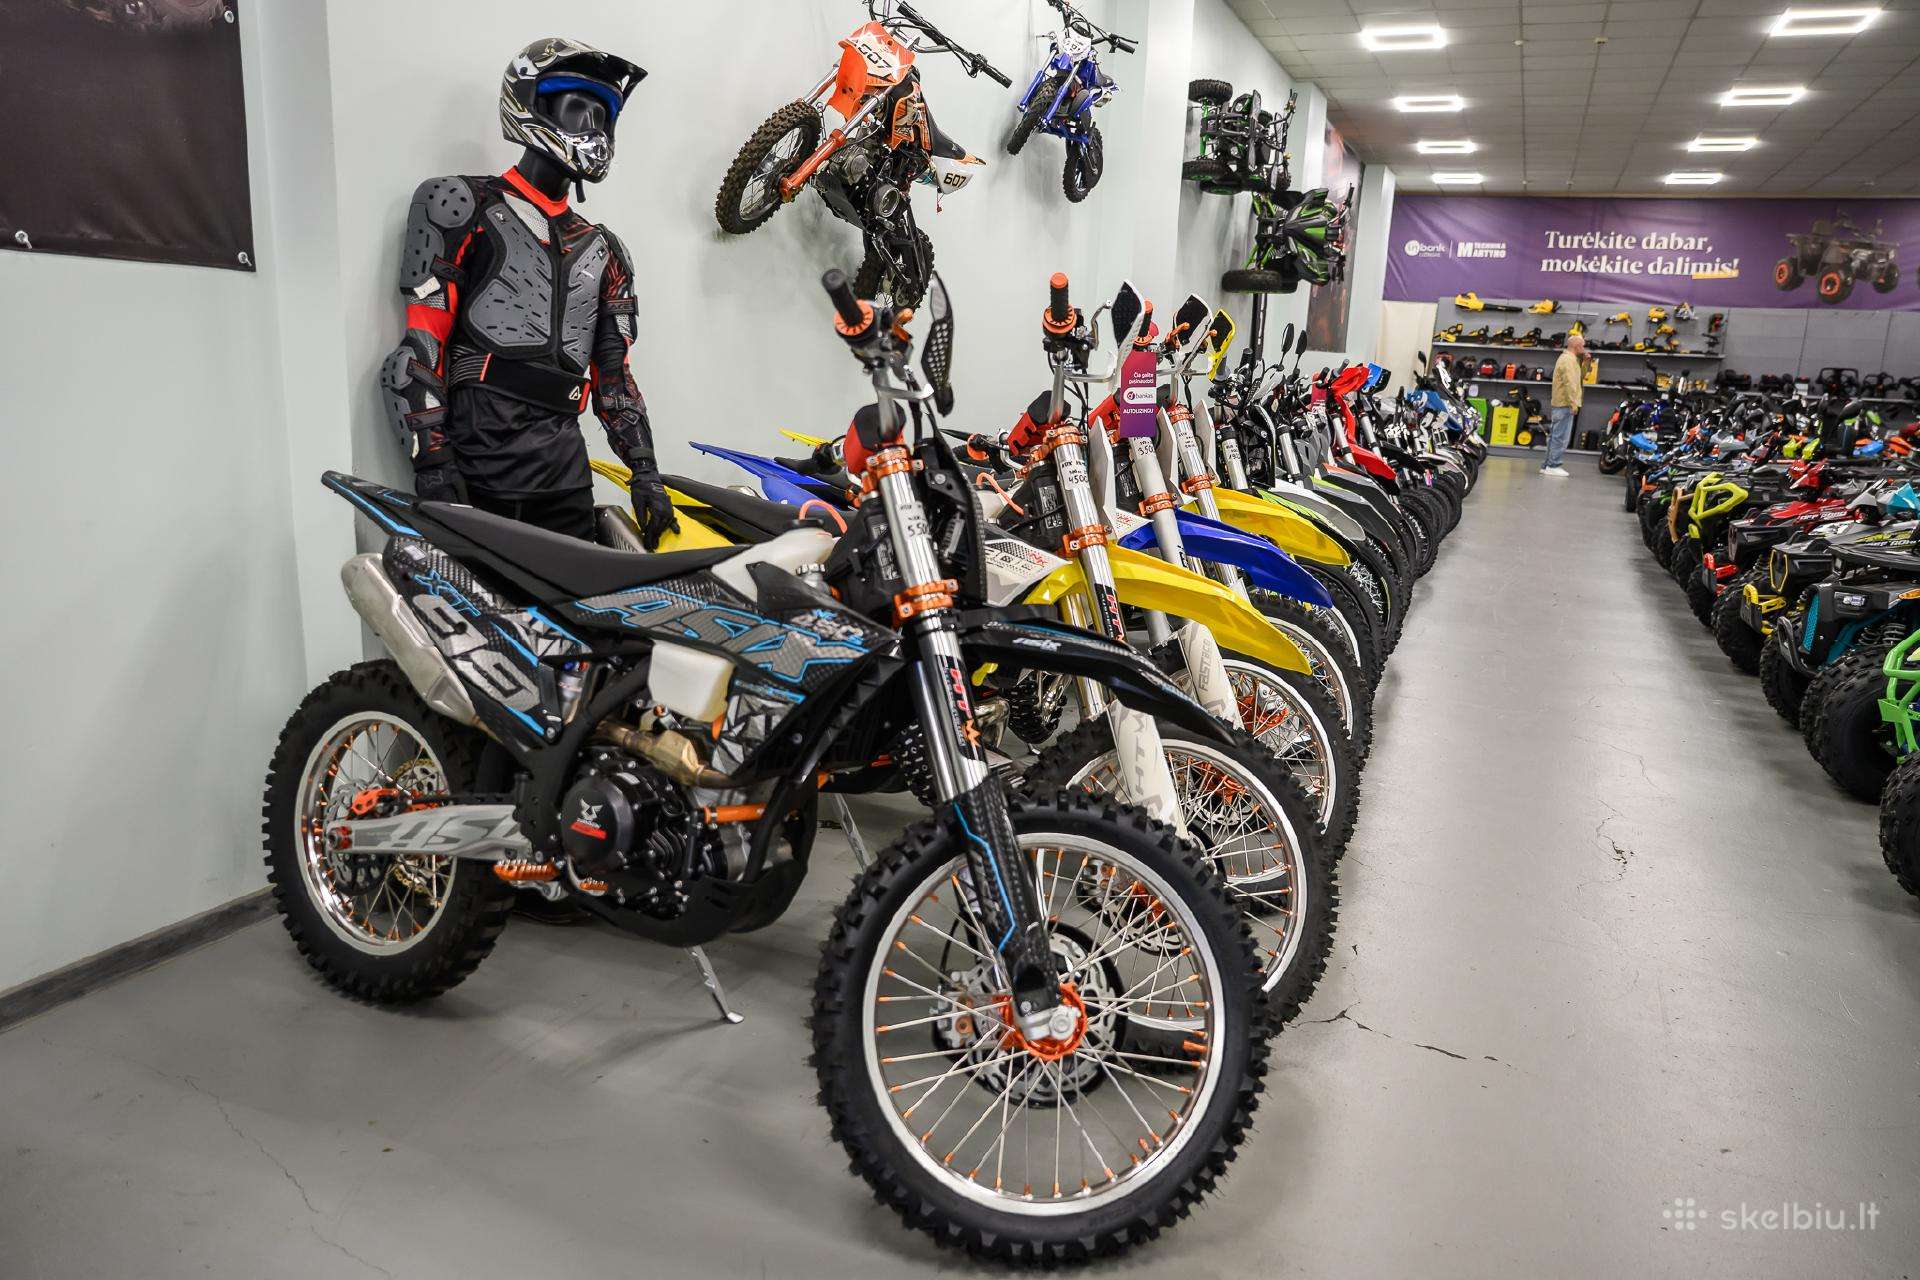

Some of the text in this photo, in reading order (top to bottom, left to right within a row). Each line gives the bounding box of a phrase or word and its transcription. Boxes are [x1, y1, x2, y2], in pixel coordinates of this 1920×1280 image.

[943, 172, 967, 187] 607
[1544, 231, 1713, 254] Turėkite dabar,
[1540, 255, 1740, 278] mokėkite dalimis!
